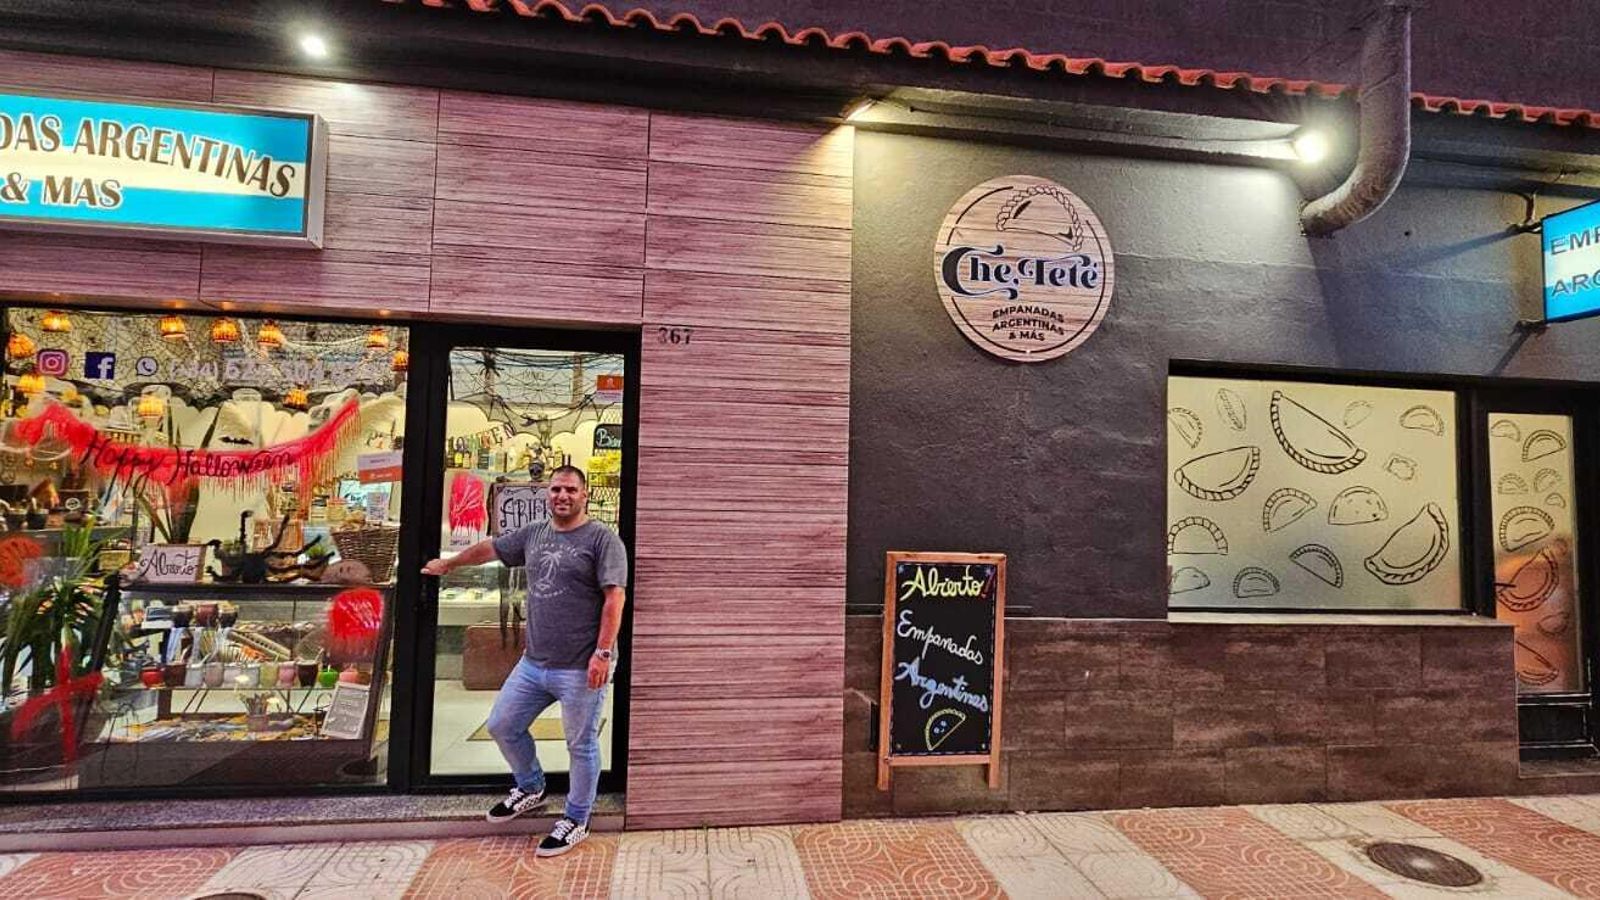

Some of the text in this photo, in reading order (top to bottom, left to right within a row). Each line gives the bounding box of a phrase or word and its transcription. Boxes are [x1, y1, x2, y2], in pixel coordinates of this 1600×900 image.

[73, 118, 295, 198] ARGENTINAS
[1, 172, 121, 208] & MAS
[1018, 254, 1098, 290] Teté
[992, 305, 1065, 323] EMPANADAS
[992, 318, 1065, 336] ARGENTINAS
[659, 327, 694, 345] 367
[1008, 330, 1046, 341] & MÁS
[80, 430, 165, 506] Happy
[165, 445, 293, 486] Halloween
[897, 609, 984, 665] Empanadas
